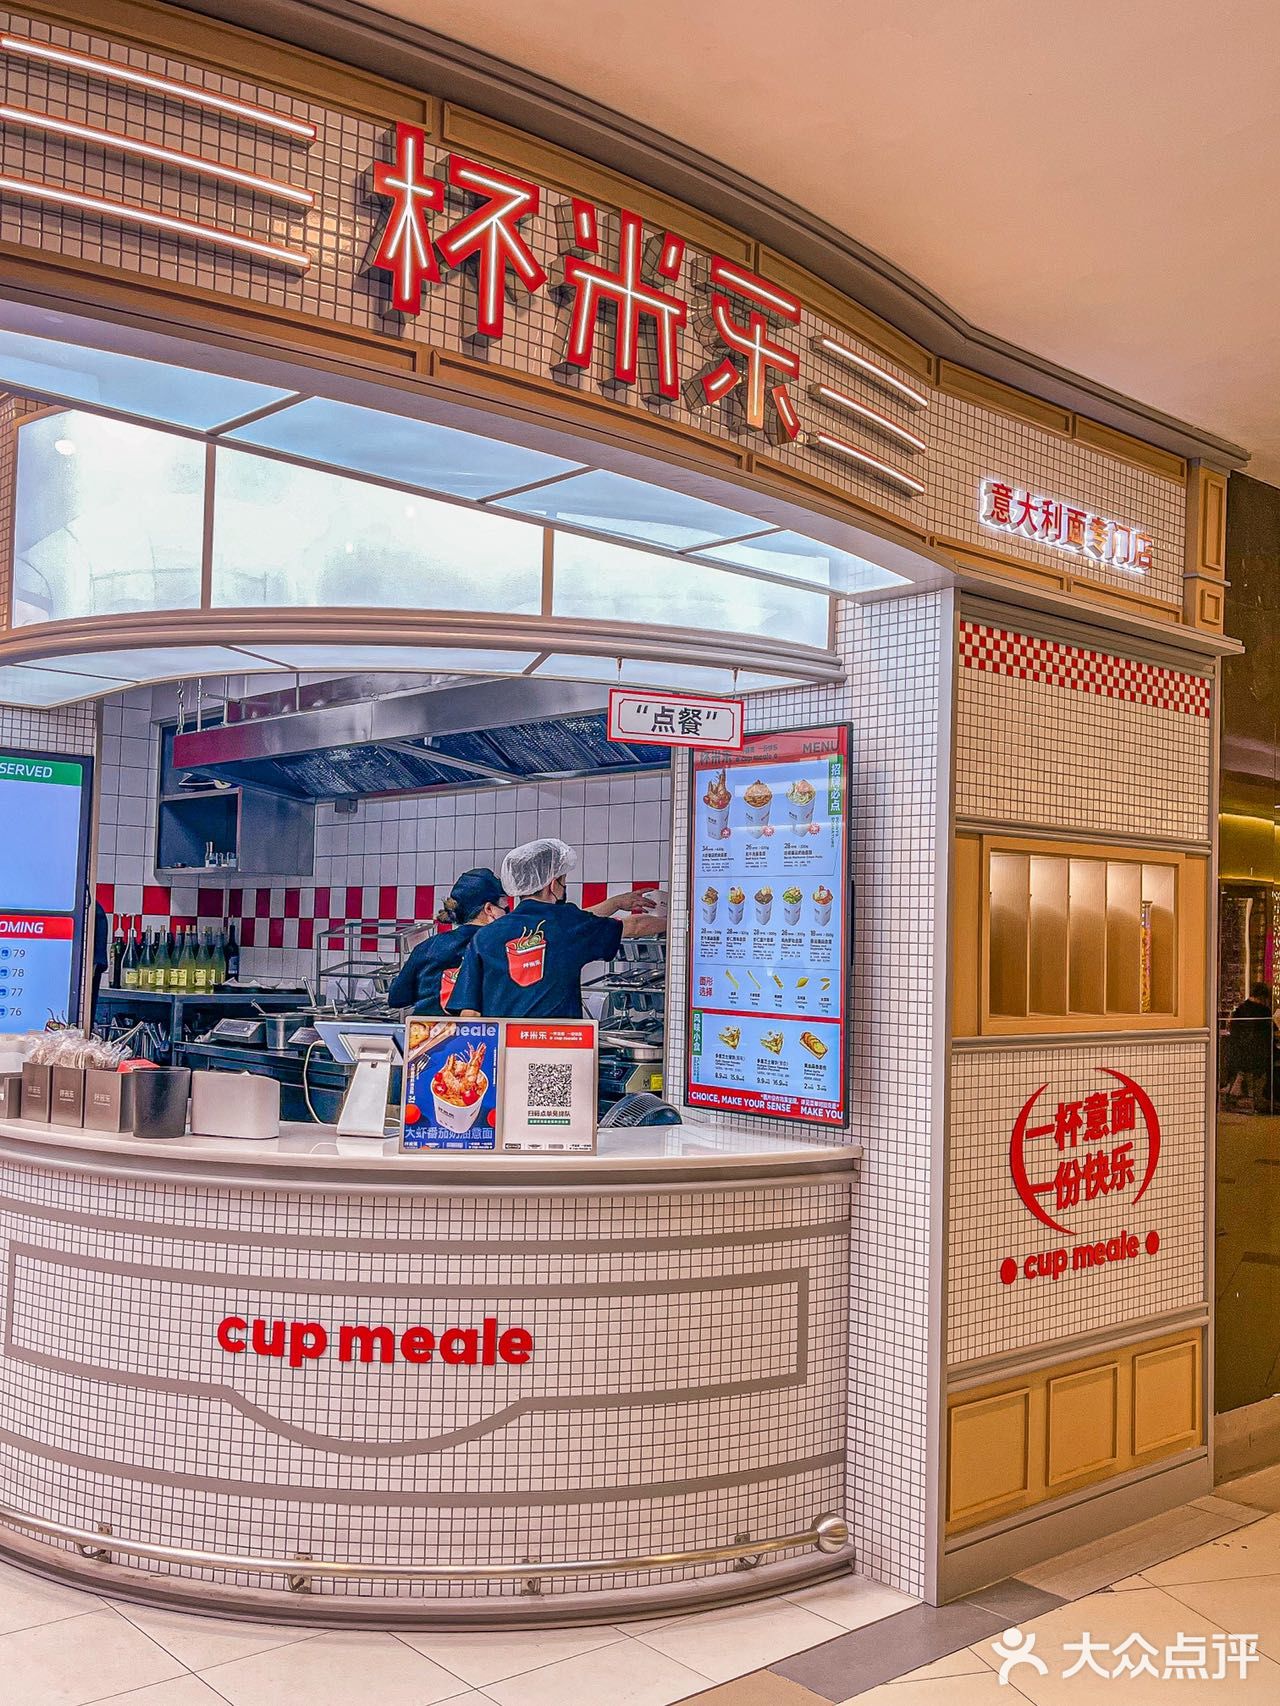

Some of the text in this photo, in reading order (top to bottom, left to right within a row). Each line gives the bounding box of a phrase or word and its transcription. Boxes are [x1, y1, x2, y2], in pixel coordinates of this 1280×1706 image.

[987, 482, 1153, 571] 意大利面专门店
[802, 740, 840, 754] MENU
[0, 762, 53, 778] SERVED
[13, 948, 26, 958] 79
[12, 968, 25, 978] 78
[11, 987, 23, 996] 77
[10, 1007, 22, 1017] 76
[691, 1091, 720, 1104] CHOICE,
[721, 1095, 743, 1106] MAKE
[743, 1098, 765, 1109] YOUR
[766, 1101, 791, 1113] SENSE
[800, 1105, 824, 1116] MAKE
[1025, 1087, 1137, 1151] 一杯意面
[1028, 1141, 1136, 1211] 一份快乐
[1023, 1230, 1140, 1281] cup meale
[217, 1316, 533, 1367] cup meale
